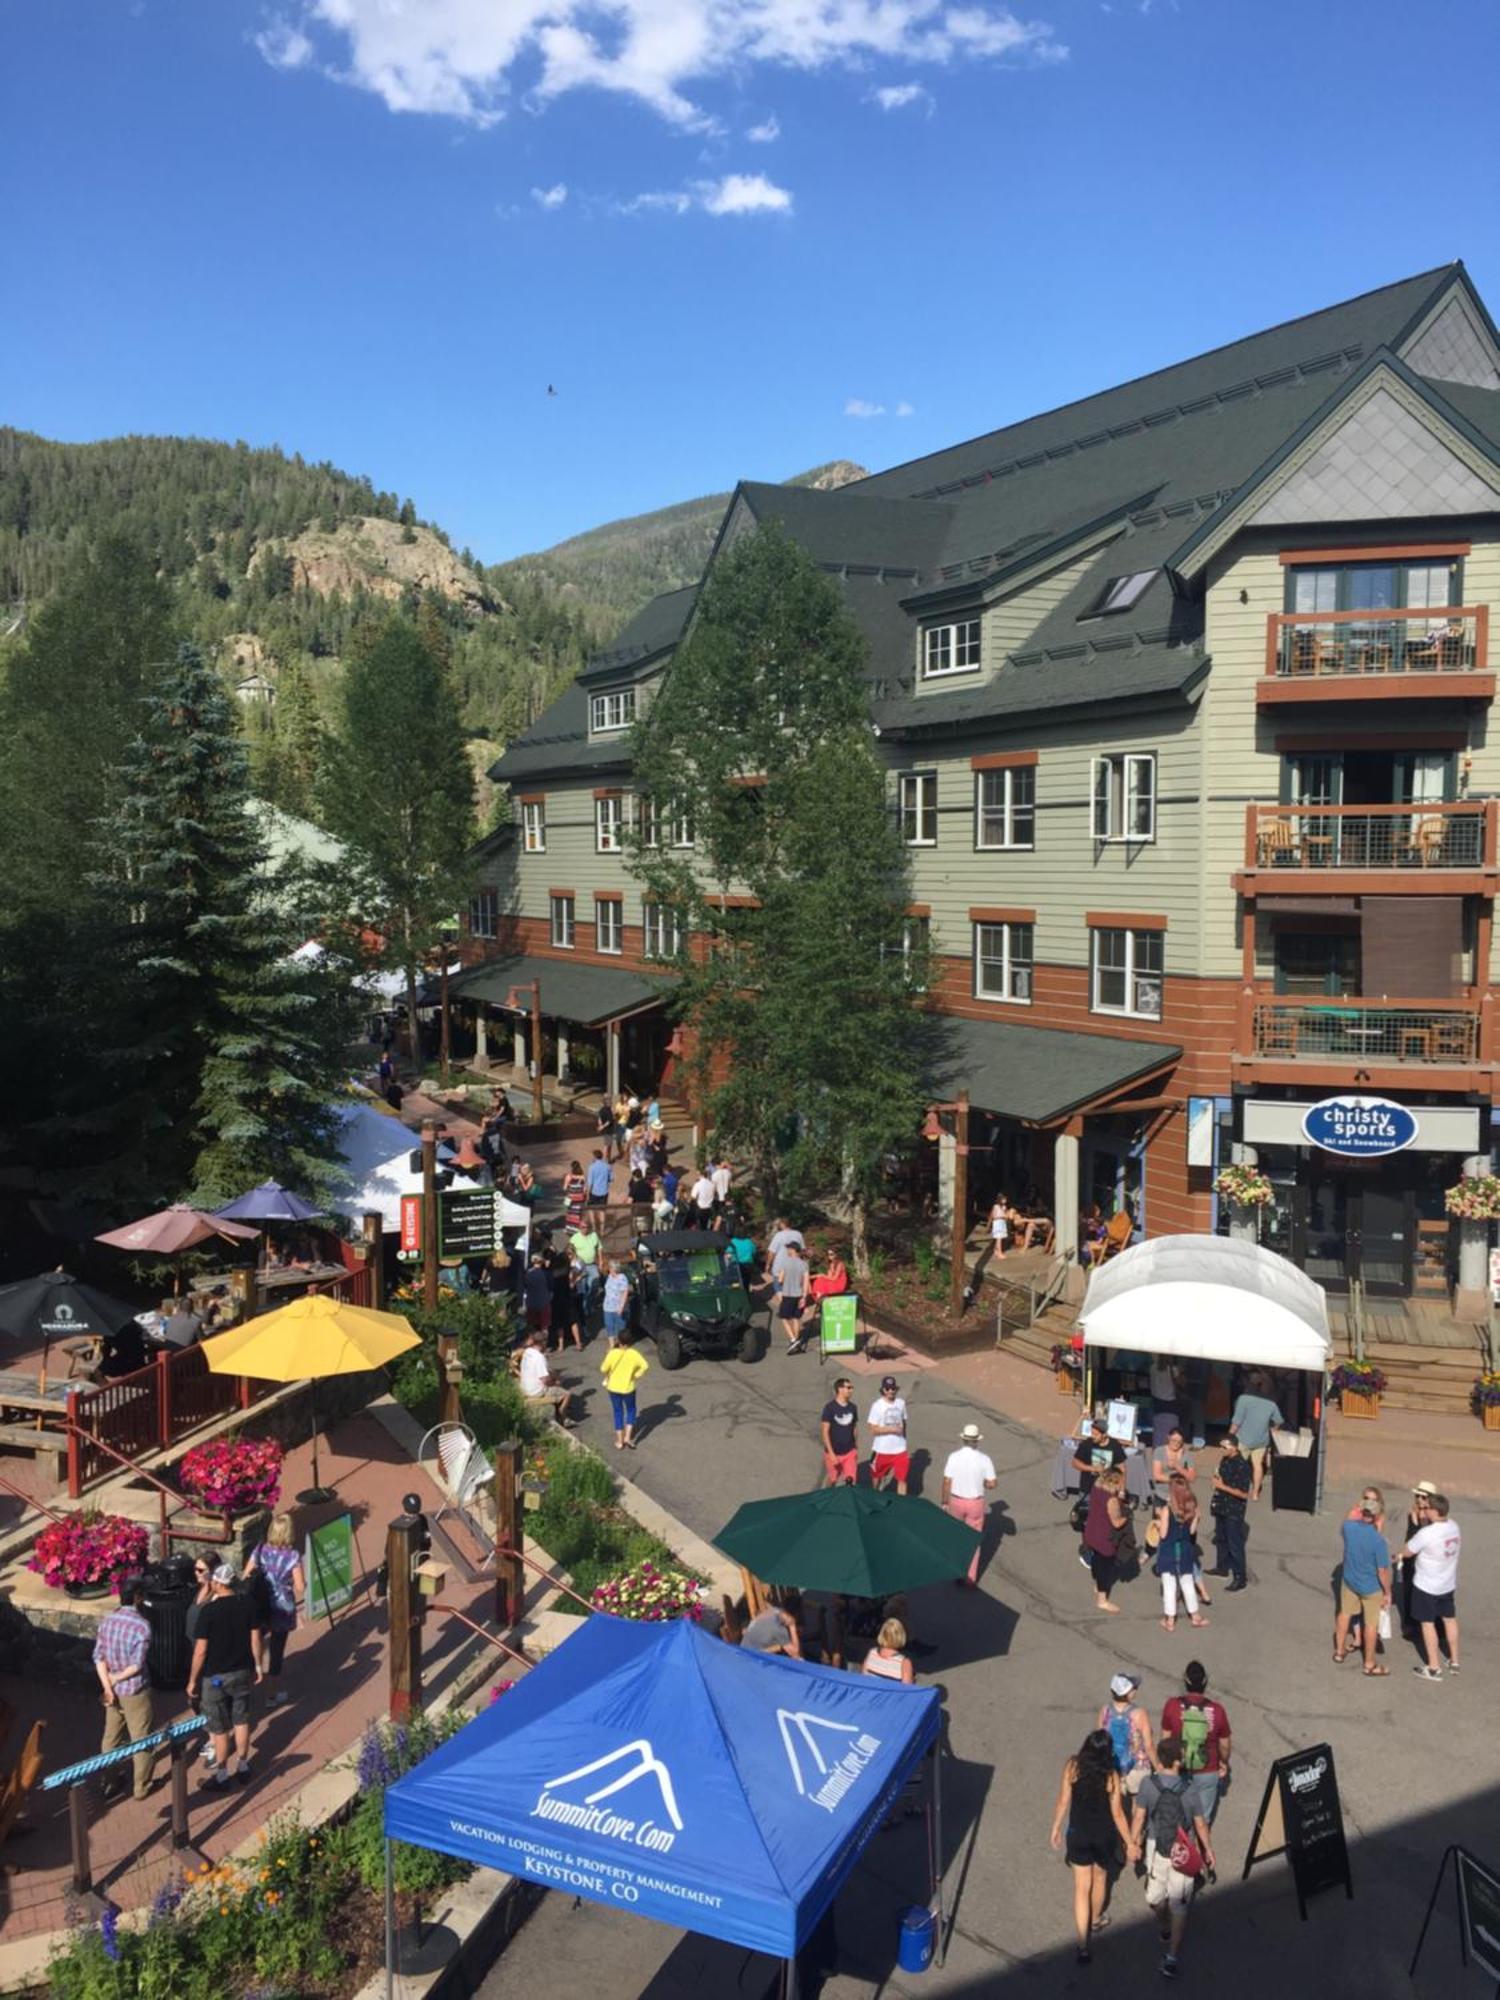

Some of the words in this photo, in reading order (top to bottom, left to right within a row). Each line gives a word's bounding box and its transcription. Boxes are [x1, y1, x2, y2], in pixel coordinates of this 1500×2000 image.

[1323, 1108, 1391, 1127] christy
[1334, 1122, 1397, 1138] sports
[1338, 1138, 1351, 1146] and
[1354, 1138, 1396, 1147] Snowboard
[806, 1733, 882, 1814] SummitCove.Com
[529, 1791, 676, 1853] SummitCove.Com
[449, 1820, 505, 1845] VACATION
[508, 1838, 562, 1861] LODGING
[565, 1853, 574, 1866] &
[576, 1856, 634, 1883] PROPERTY
[636, 1873, 723, 1909] MANAGEMENT
[524, 1856, 608, 1896] KEYSTONE,
[611, 1881, 639, 1903] CO
